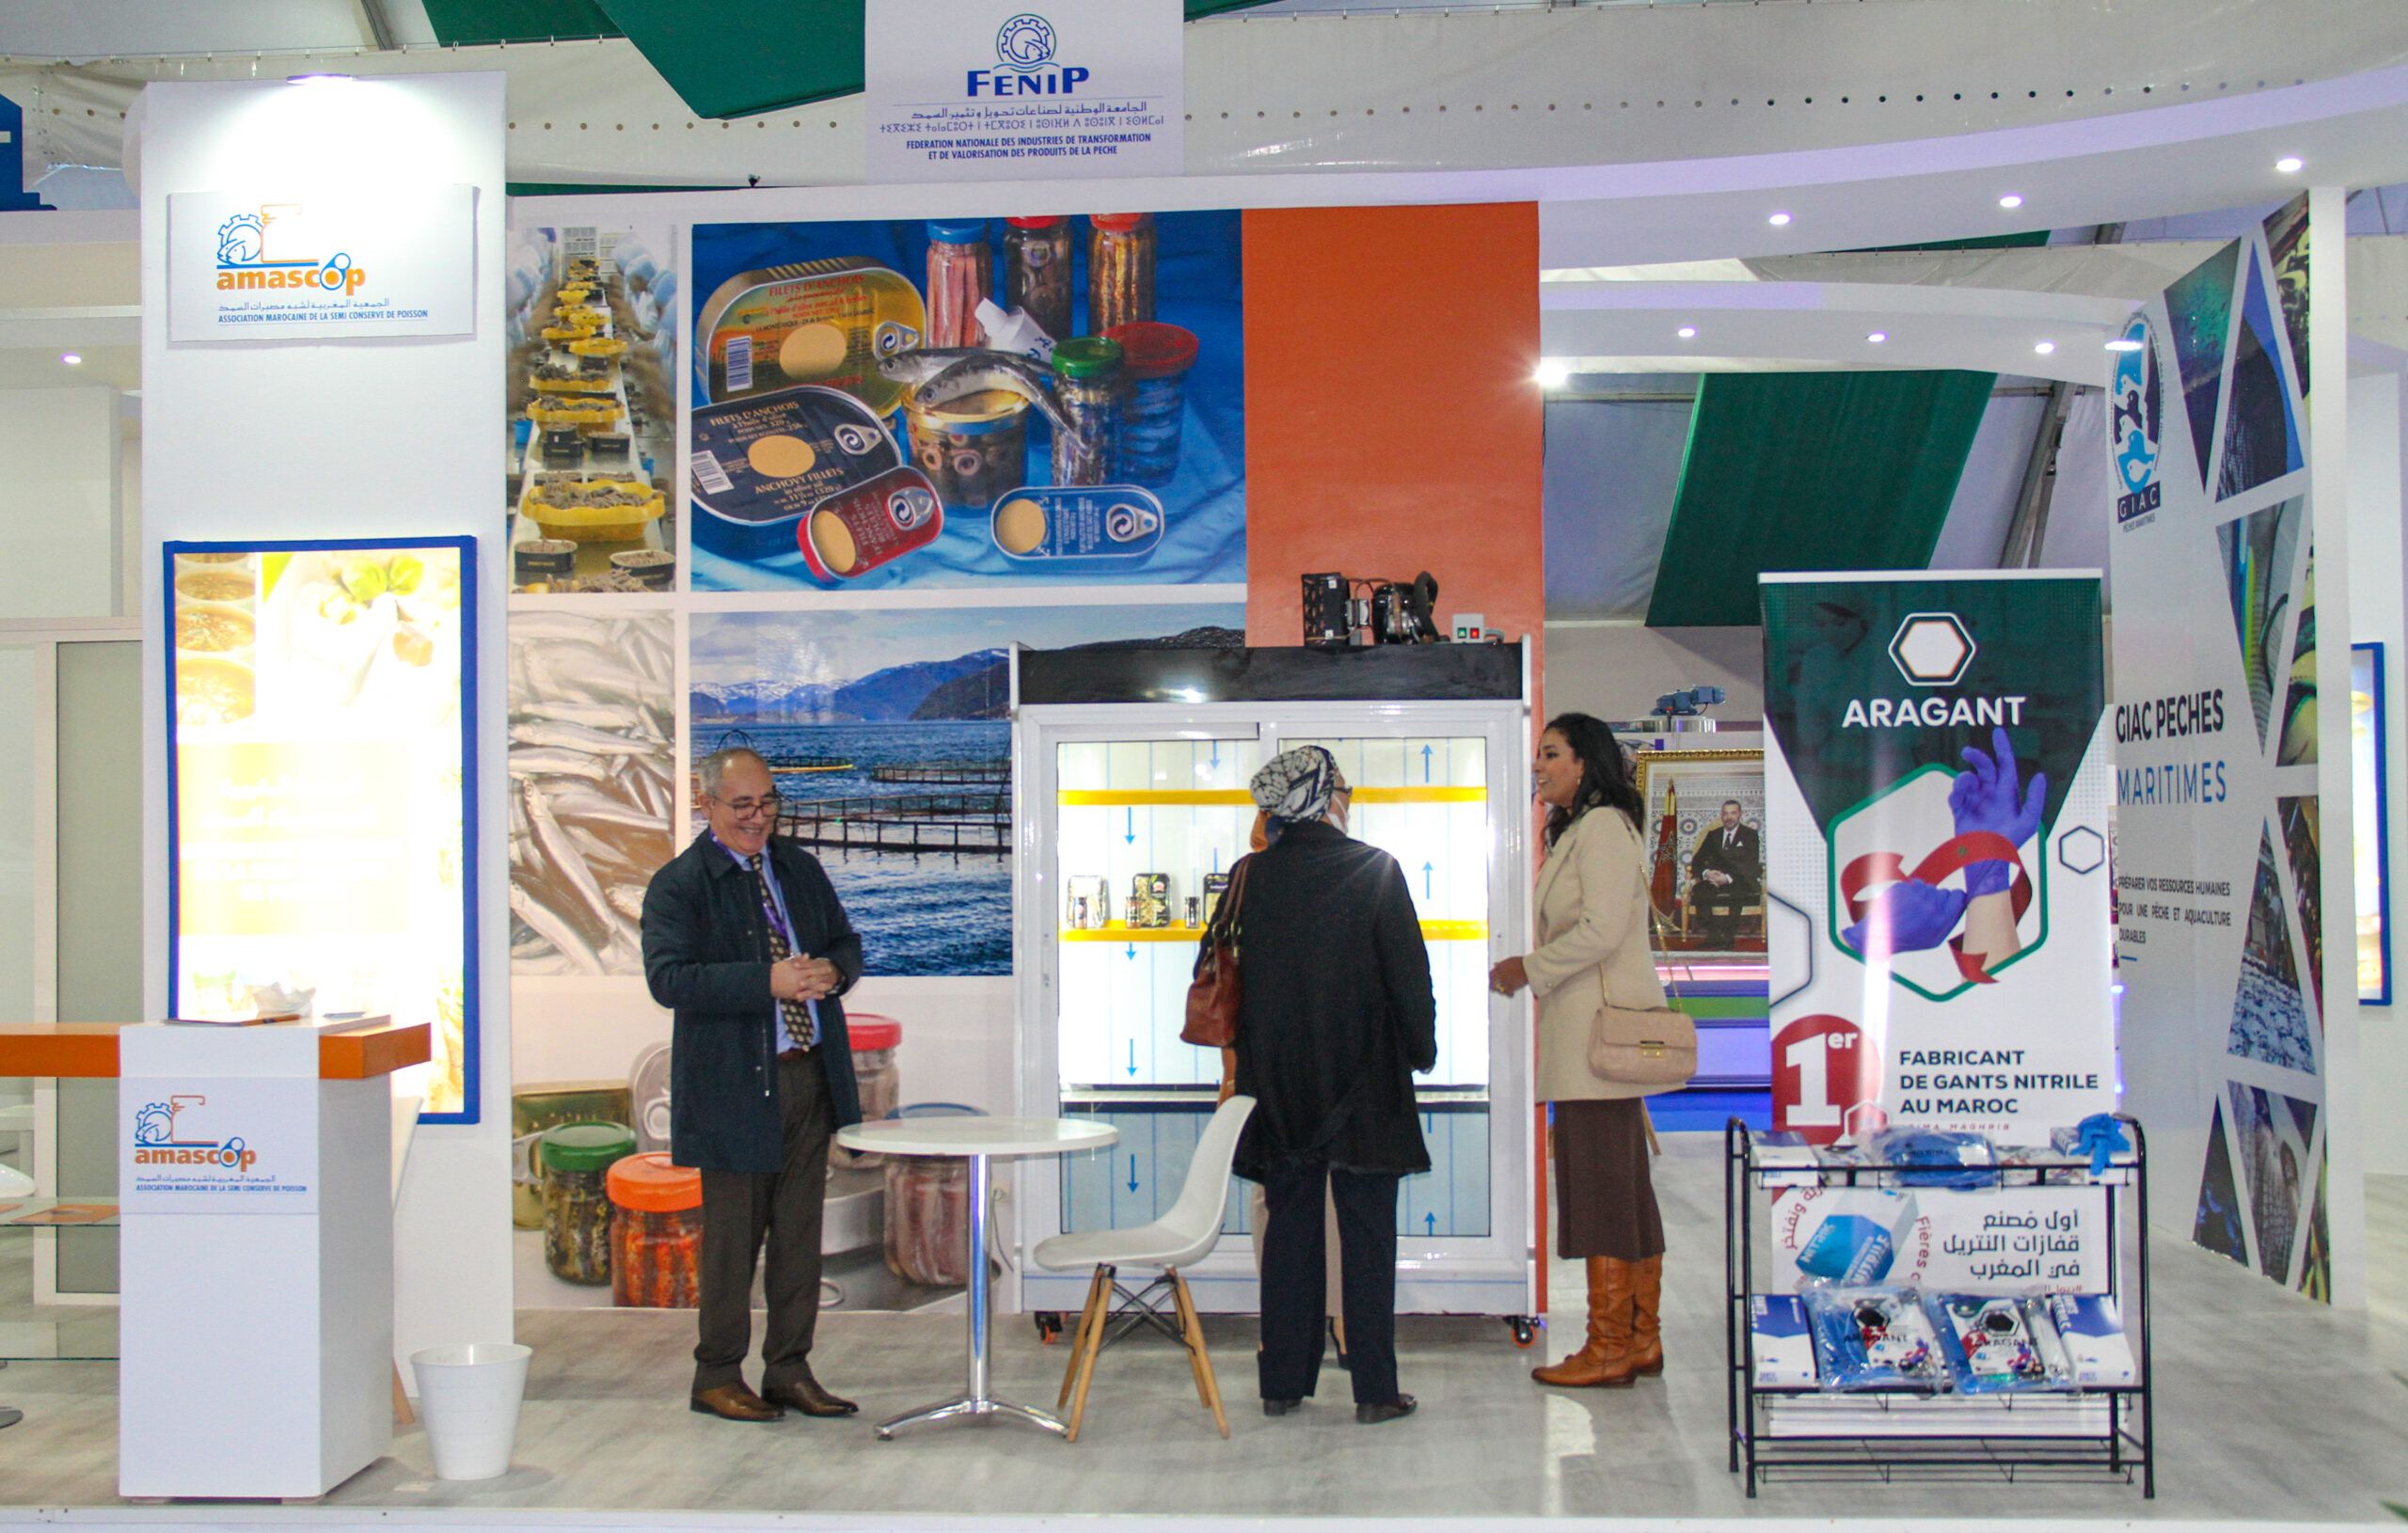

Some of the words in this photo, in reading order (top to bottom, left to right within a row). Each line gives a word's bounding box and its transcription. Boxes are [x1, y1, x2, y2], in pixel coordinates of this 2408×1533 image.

[967, 67, 1089, 97] FENIP
[911, 107, 947, 119] السمك
[1065, 103, 1104, 116] الوطنية
[1107, 102, 1147, 114] الجامعة
[907, 139, 953, 150] FEDERATION
[956, 137, 999, 148] NATIONALE
[1002, 137, 1016, 147] DES
[1018, 135, 1064, 146] INDUSTRIES
[1066, 135, 1075, 144] DE
[1078, 134, 1151, 144] TRANSFORMATION
[928, 151, 937, 160] ET
[940, 150, 949, 160] DE
[952, 149, 1008, 159] VALORISATION
[1010, 148, 1025, 157] DES
[1027, 147, 1068, 157] PRODUITS
[1069, 147, 1079, 155] DE
[1081, 146, 1091, 155] LA
[1093, 145, 1117, 154] PECHE
[216, 266, 366, 296] amascop
[218, 314, 263, 323] ASSOCIATION
[265, 312, 308, 322] MAROCAINE
[309, 312, 318, 321] DE
[330, 311, 347, 320] SEMI
[349, 310, 384, 319] CONSERVE
[397, 309, 428, 318] POISSON
[710, 413, 741, 426] FILETS
[754, 475, 806, 494] ANCHOVY
[807, 467, 845, 482] FILLETS
[2119, 487, 2157, 518] GIAC
[1842, 696, 2026, 728] ARAGANT
[2115, 701, 2152, 744] GIAC
[2156, 688, 2224, 739] PECHES
[2117, 760, 2226, 806] MARITIMES
[2147, 878, 2158, 892] VOS
[2159, 878, 2194, 894] RESSOURCES
[2195, 881, 2230, 896] HUMAINES
[2118, 902, 2133, 916] POUR
[2137, 904, 2148, 918] UNE
[2173, 907, 2180, 921] ET
[2184, 909, 2231, 926] AQUACULTURE
[2118, 927, 2147, 943] DURABLES
[1900, 1050, 2025, 1066] FABRICANT
[1900, 1075, 1928, 1090] DE
[1934, 1074, 2007, 1090] GANTS
[2015, 1074, 2099, 1090] NITRILE
[1900, 1099, 1930, 1114] AU
[1938, 1098, 2019, 1114] MAROC
[135, 1147, 257, 1173] amascop
[1915, 1215, 1931, 1269] Fières
[1943, 1234, 2005, 1256] النتريل
[2013, 1235, 2080, 1256] قفازات
[1970, 1258, 2039, 1280] المغرب
